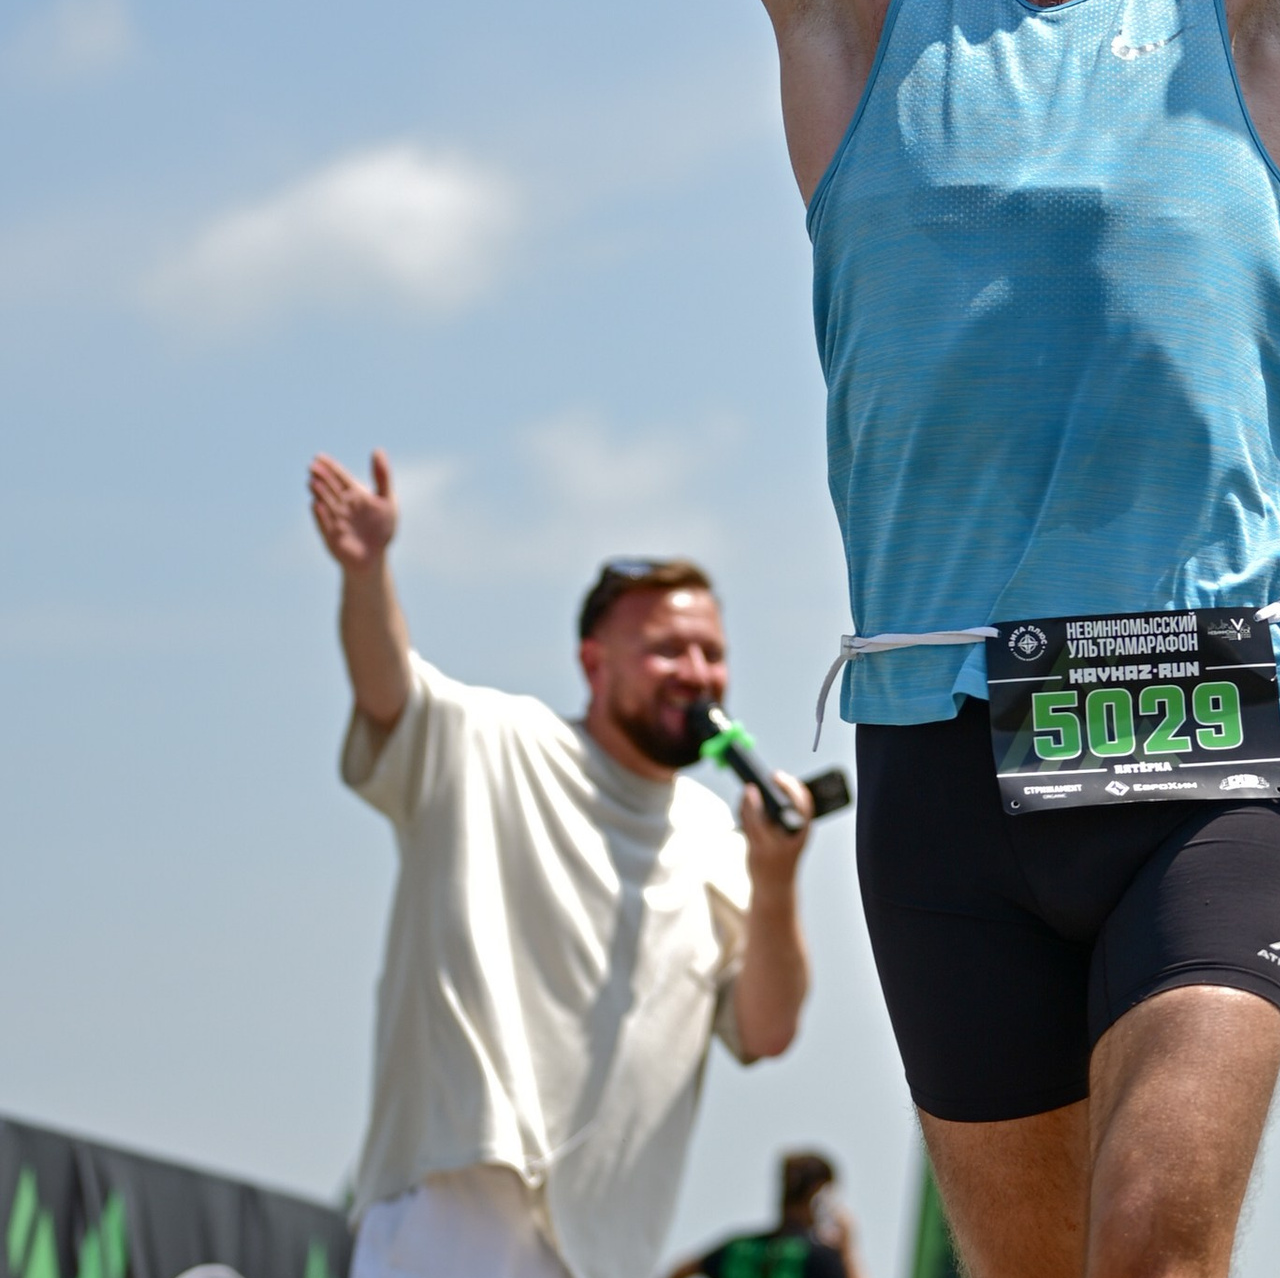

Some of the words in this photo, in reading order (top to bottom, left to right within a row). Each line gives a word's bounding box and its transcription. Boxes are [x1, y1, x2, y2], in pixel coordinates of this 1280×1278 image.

[1066, 612, 1198, 639] НЕВИННОМЫССКИЙ
[1067, 633, 1199, 658] УЛЬТРАМАРАФОН
[1032, 681, 1244, 761] 5029
